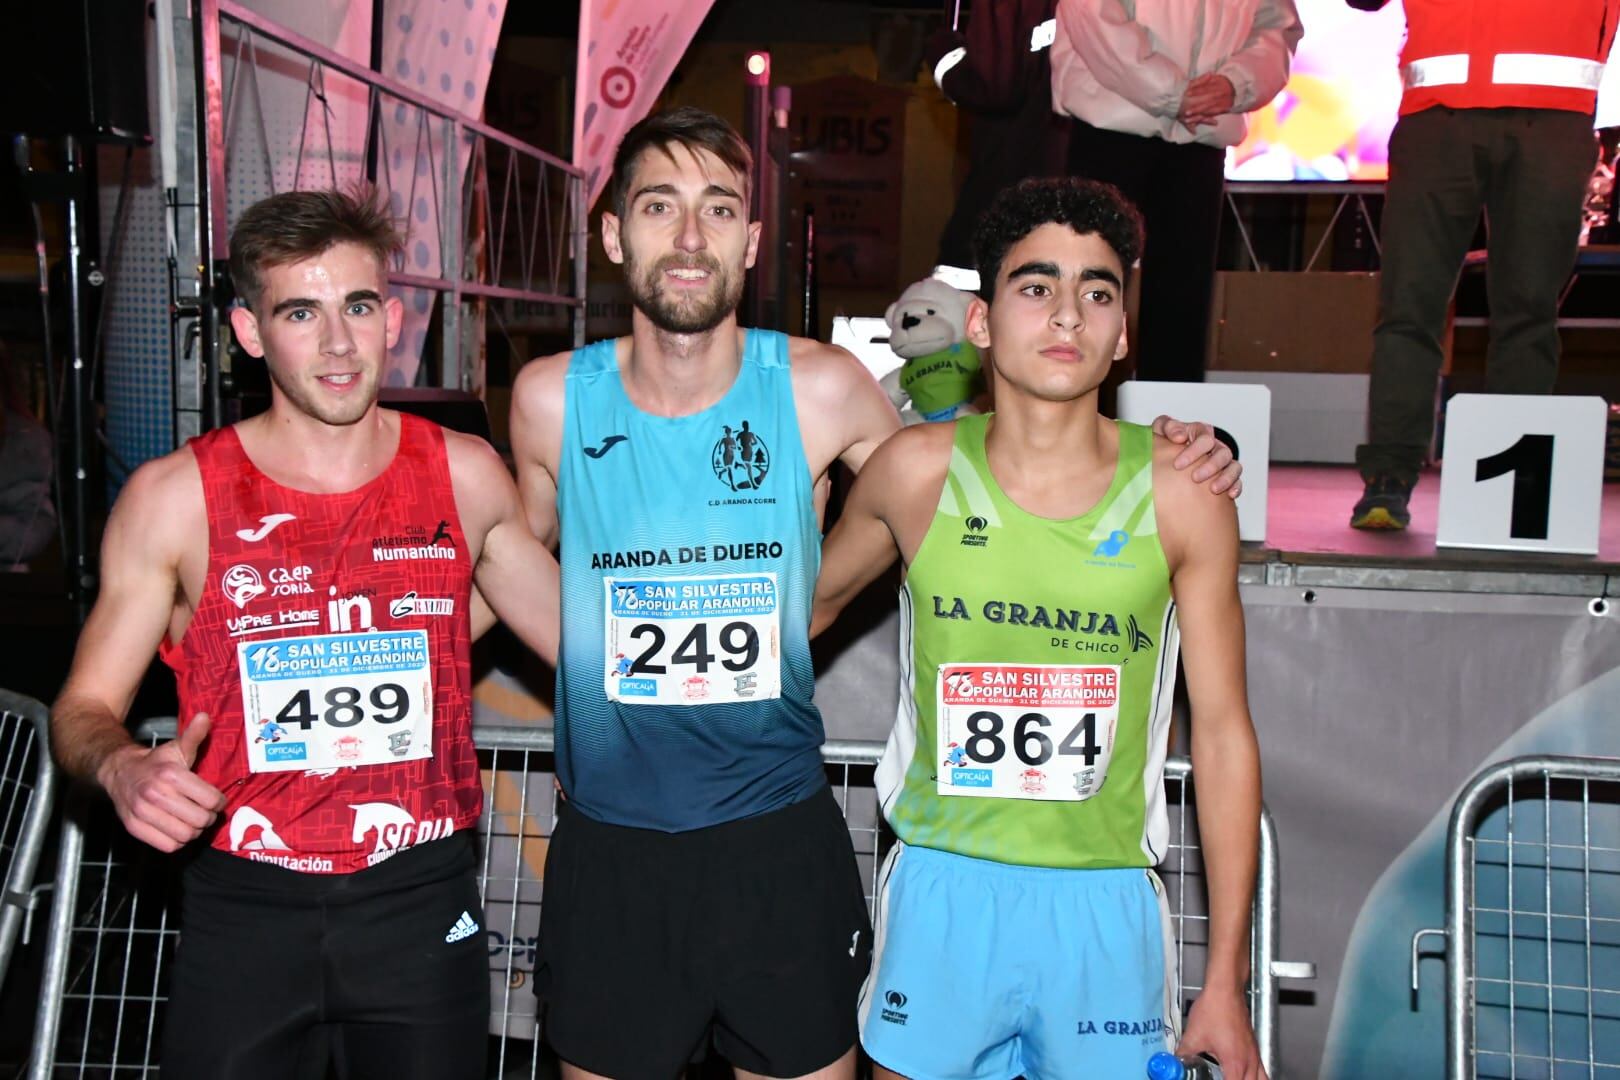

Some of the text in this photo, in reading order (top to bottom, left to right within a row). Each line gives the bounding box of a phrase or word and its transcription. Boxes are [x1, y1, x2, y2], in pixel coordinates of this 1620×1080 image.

[1475, 434, 1554, 540] 1
[722, 498, 752, 506] ARANDA
[754, 497, 776, 505] CORRE
[405, 524, 426, 535] Club
[372, 535, 427, 548] Atletismo
[372, 544, 456, 561] Numantino
[591, 541, 783, 570] ARANDA DE DUERO
[645, 582, 774, 599] SAN SILVESTRE
[638, 597, 774, 612] POPULAR ARANDINA
[932, 595, 1121, 637] LA GRANJA
[287, 636, 425, 659] SAN SILVESTRE
[630, 621, 760, 675] 249
[1051, 637, 1120, 653] DE CHICO
[280, 650, 426, 671] POPULAR ARANDINA
[982, 671, 1116, 687] SAN SILVESTRE
[973, 686, 1116, 700] POPULAR ARANDINA
[275, 683, 410, 730] 489
[965, 711, 1102, 766] 864
[250, 851, 333, 872] Diputación
[445, 923, 479, 943] adidas
[1077, 1018, 1164, 1035] LA GRANJA
